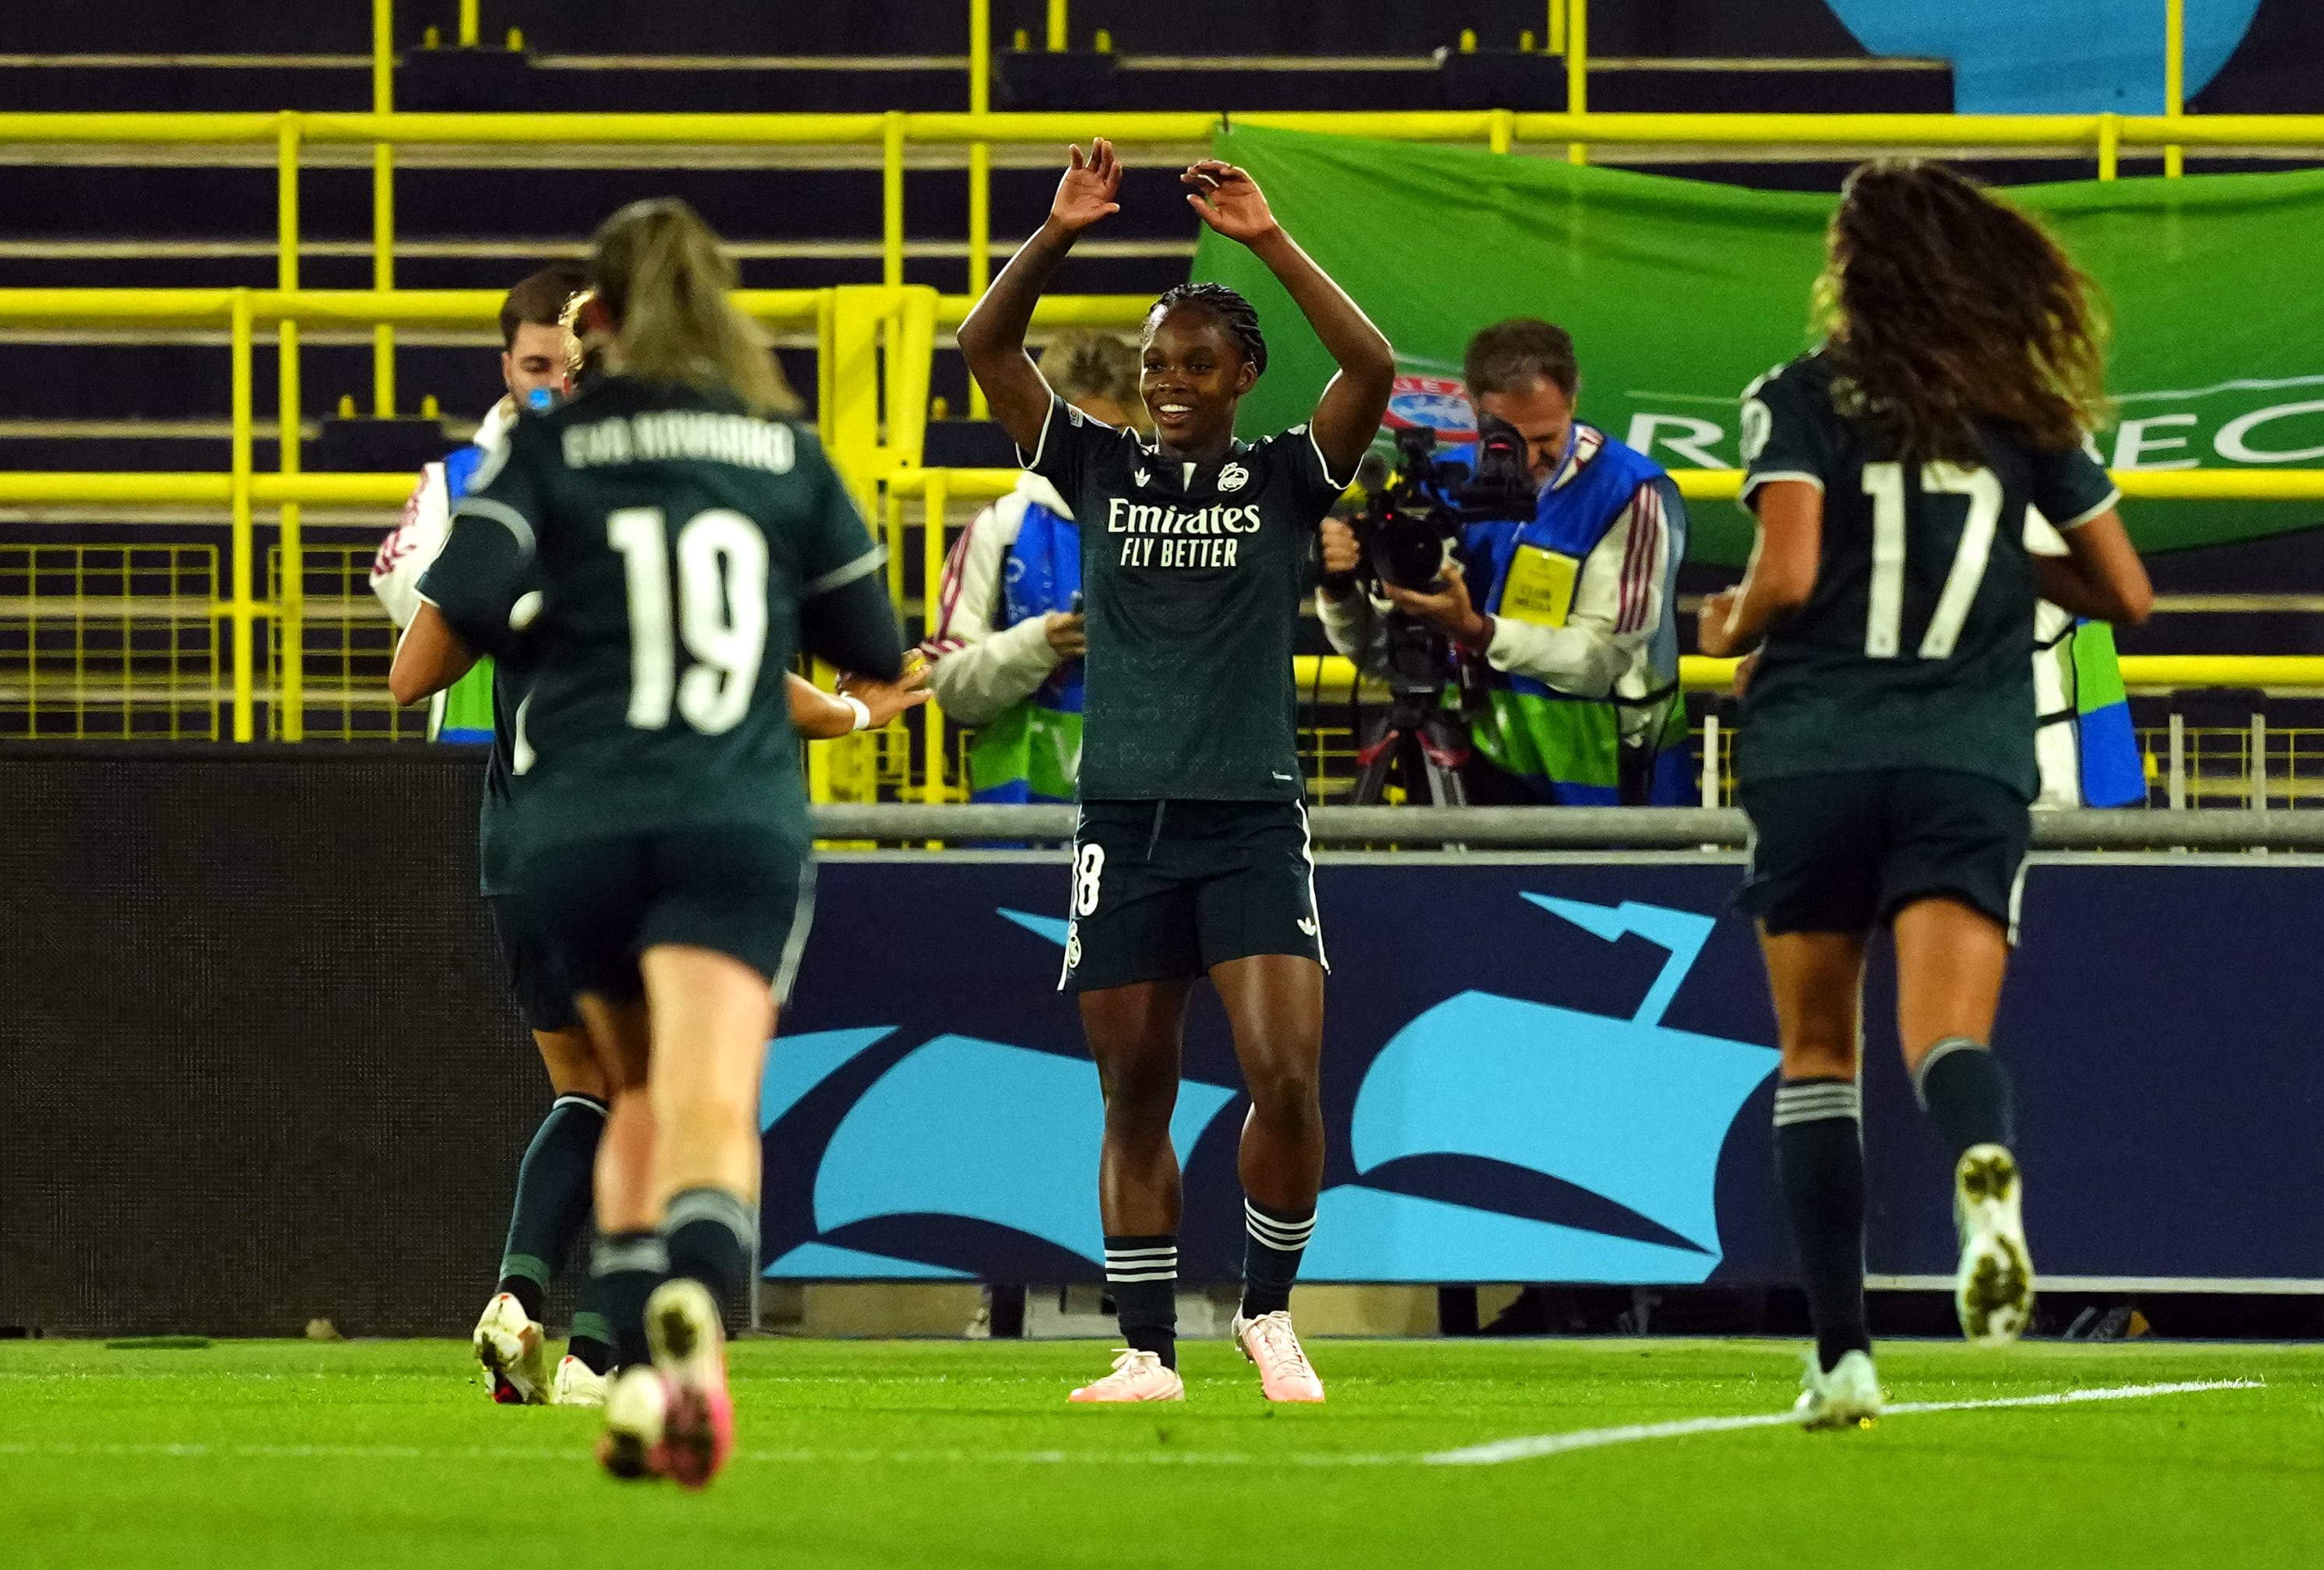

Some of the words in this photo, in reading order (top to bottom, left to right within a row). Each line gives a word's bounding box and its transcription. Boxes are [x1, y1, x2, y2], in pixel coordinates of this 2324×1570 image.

[1108, 498, 1260, 534] Emirates
[1120, 537, 1155, 568] FLY
[1160, 537, 1238, 569] BETTER
[1862, 461, 2003, 659] 17
[607, 506, 769, 734] 19
